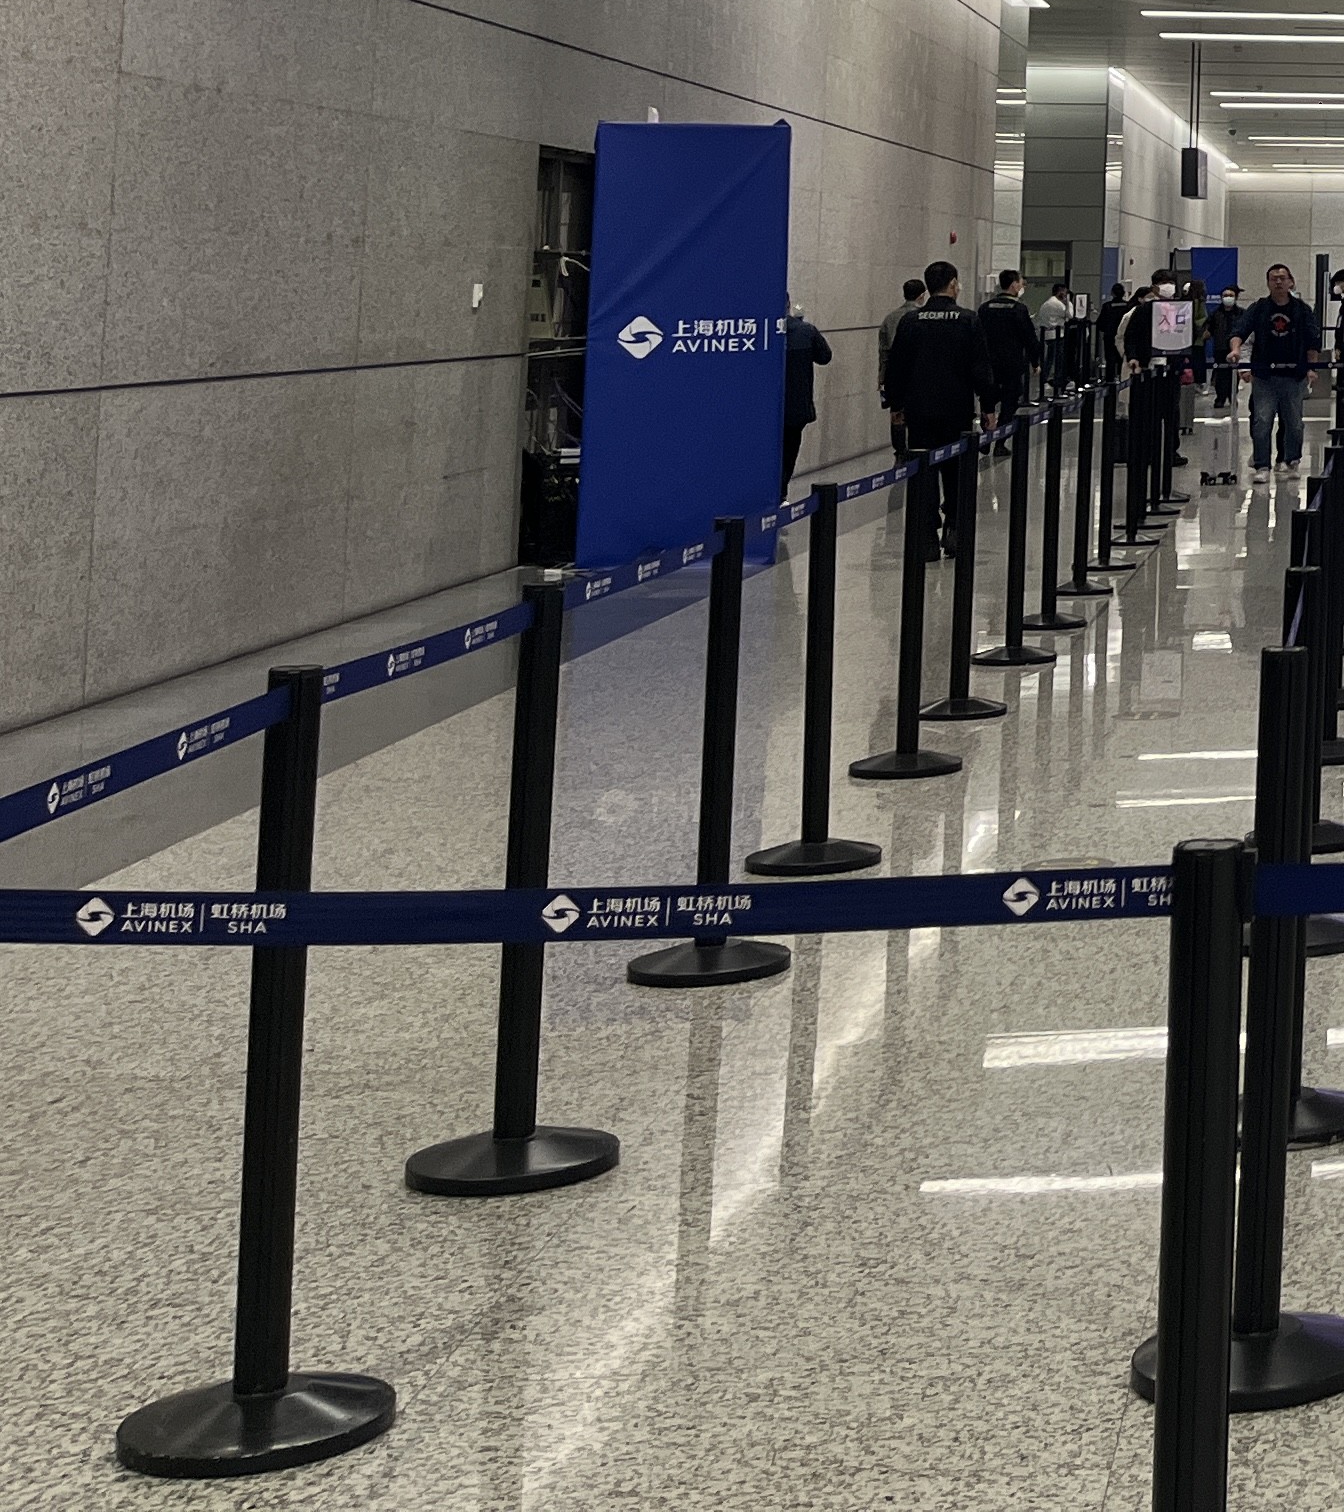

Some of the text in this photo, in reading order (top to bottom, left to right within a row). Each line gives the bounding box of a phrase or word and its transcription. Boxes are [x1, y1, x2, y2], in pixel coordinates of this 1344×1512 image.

[918, 312, 960, 321] SECURITY
[1159, 314, 1186, 326] 入口
[672, 318, 757, 337] 上海机场
[672, 338, 756, 353] AVINEX
[1046, 875, 1174, 896] 上海机场 虹桥
[587, 894, 752, 915] 上海机场 虹桥机场
[1046, 894, 1173, 910] AVINEX SH
[120, 901, 287, 920] 上海机场 虹桥机场
[120, 919, 267, 934] AVINEX SHA
[586, 913, 733, 929] AVINEX SHA
